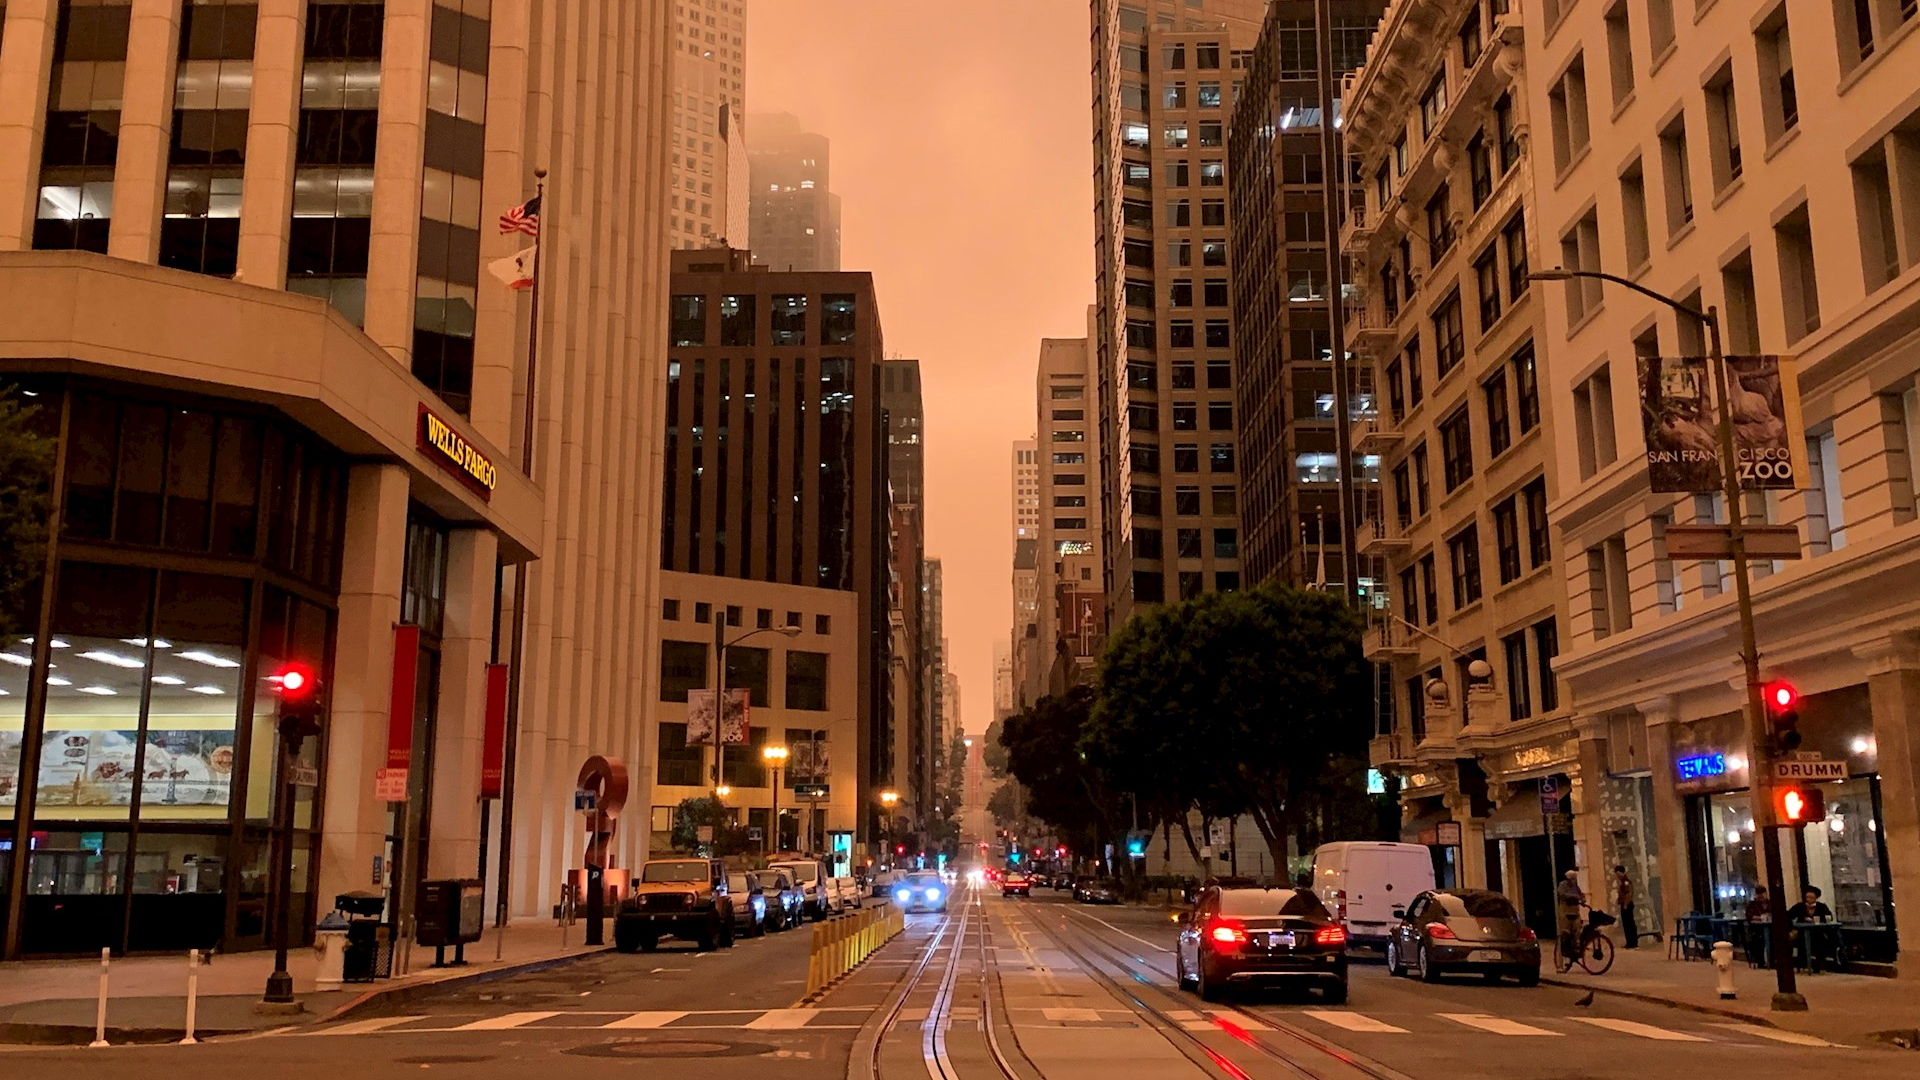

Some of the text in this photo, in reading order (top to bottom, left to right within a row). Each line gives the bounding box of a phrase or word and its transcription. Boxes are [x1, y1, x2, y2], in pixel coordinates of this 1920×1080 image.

[427, 413, 496, 490] WELLS FARGO
[1648, 450, 1718, 464] SAN FRAN
[1738, 448, 1789, 460] CISCO
[1740, 461, 1792, 479] ZOO
[1778, 764, 1843, 777] DRUMM
